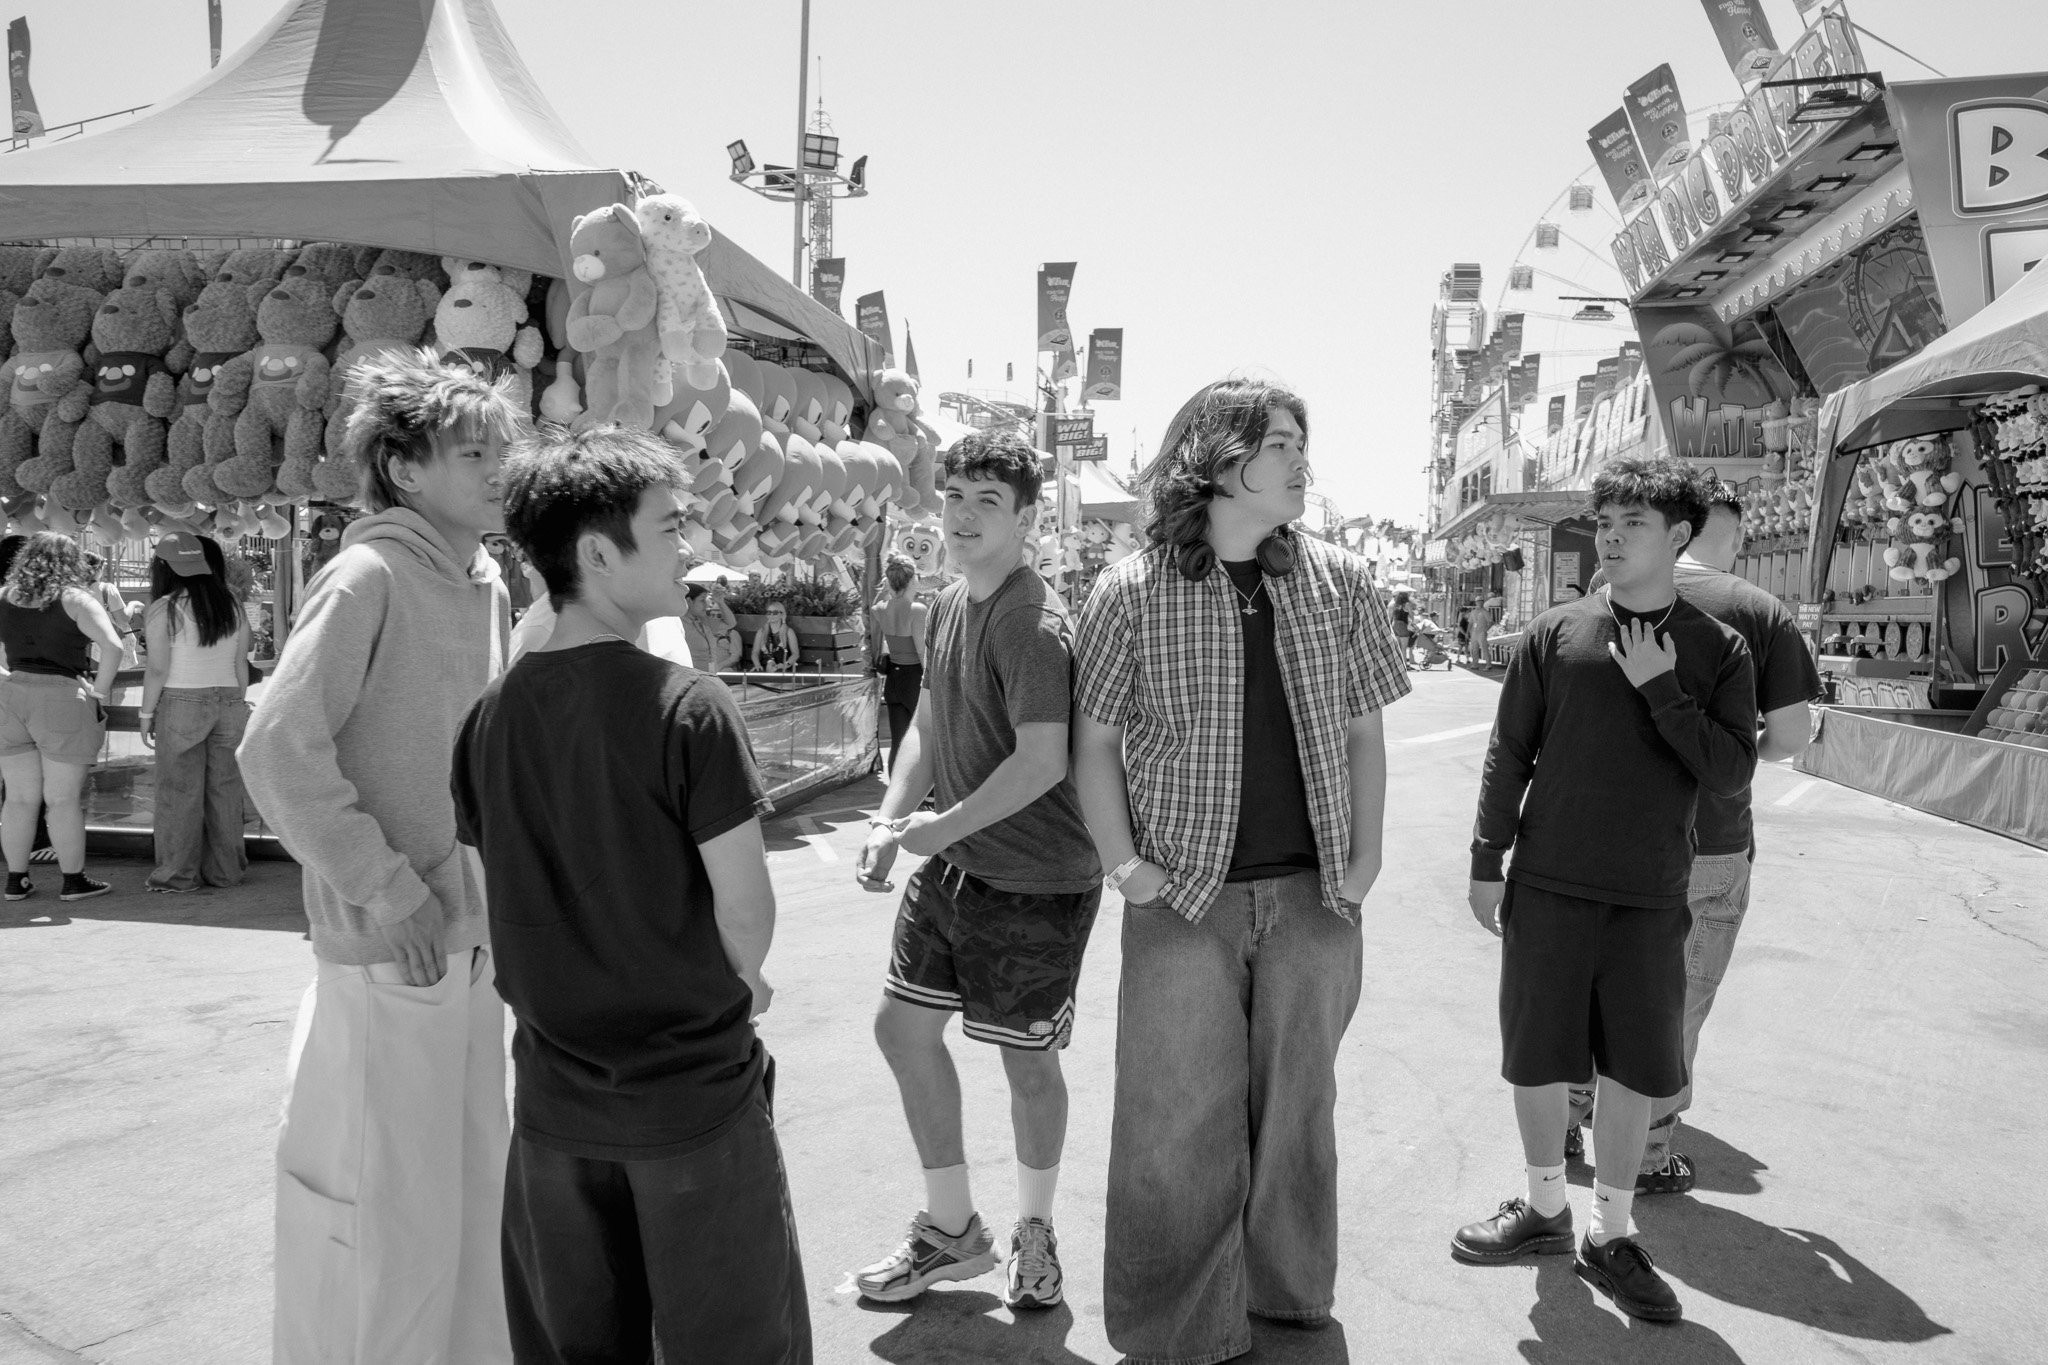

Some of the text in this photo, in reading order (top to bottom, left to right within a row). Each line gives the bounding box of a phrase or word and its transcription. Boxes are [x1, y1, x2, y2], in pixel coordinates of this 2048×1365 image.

[1610, 207, 1671, 293] WIN
[1660, 156, 1719, 250] BIG
[1057, 422, 1089, 433] WIN
[1670, 394, 1773, 458] WATE
[1058, 431, 1089, 441] BIG!
[1076, 447, 1104, 457] BIG!
